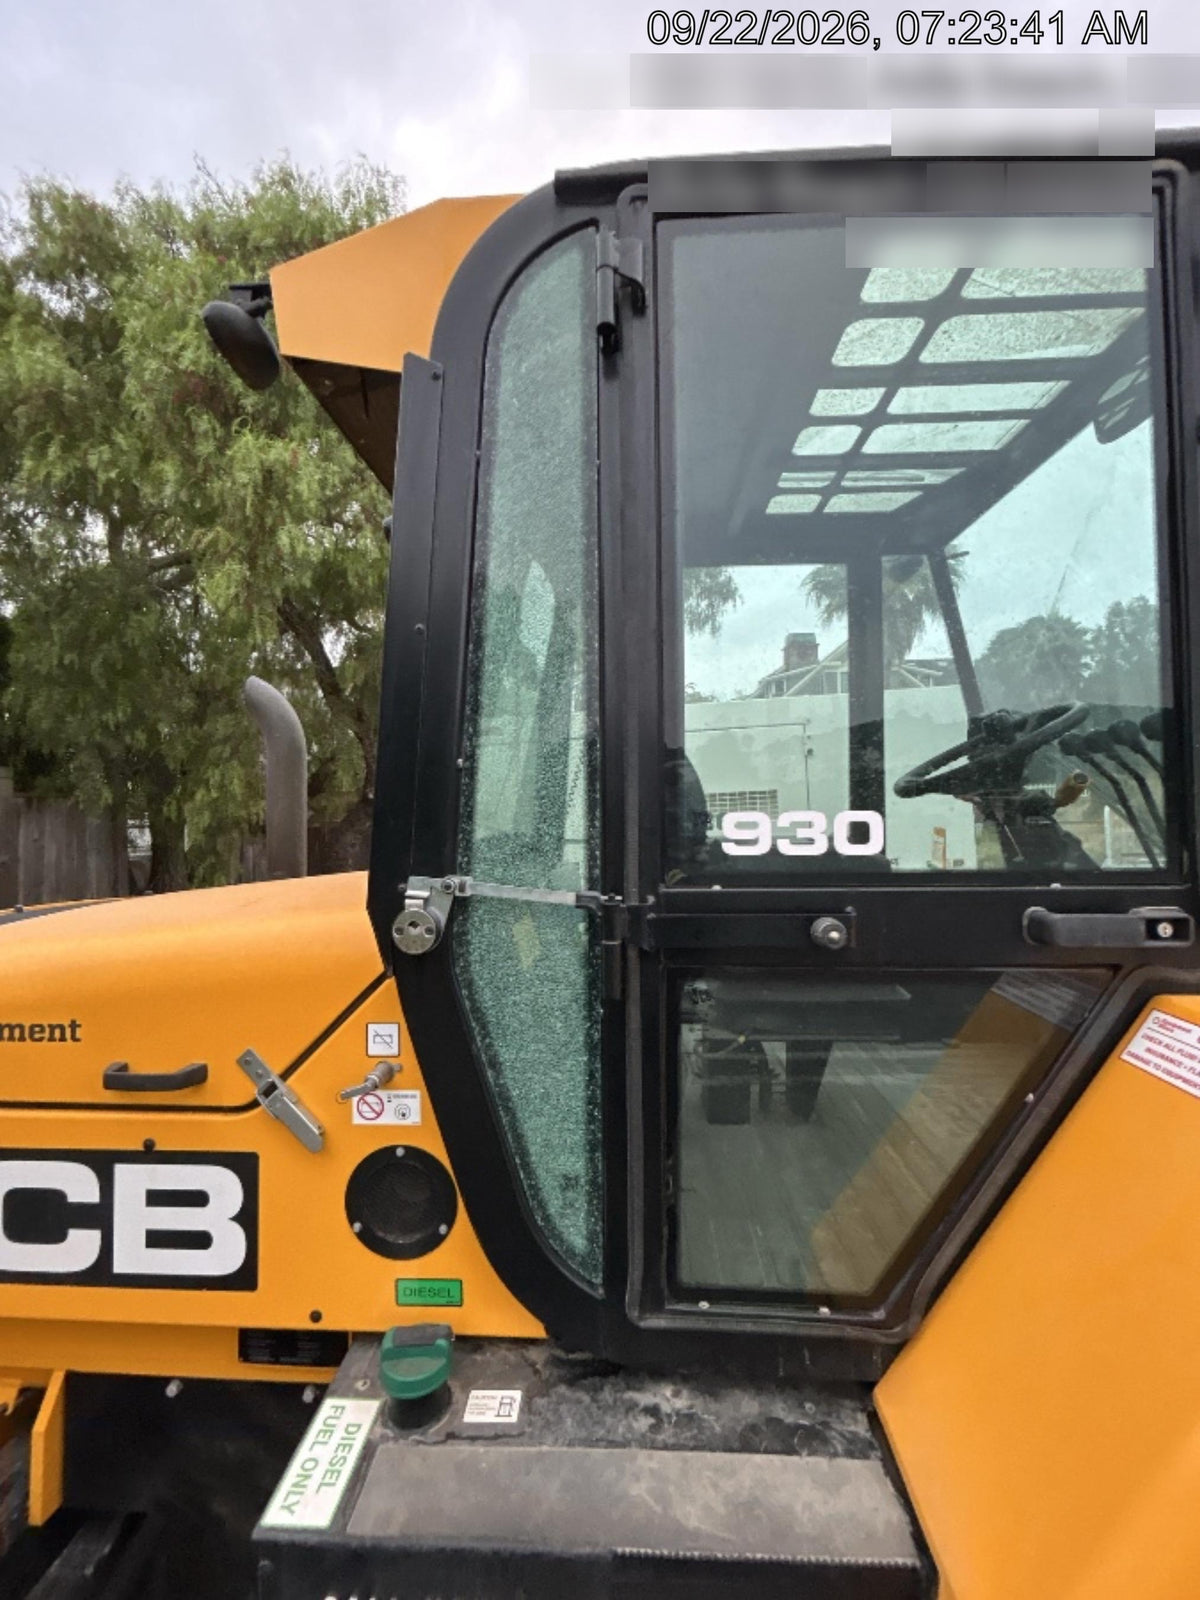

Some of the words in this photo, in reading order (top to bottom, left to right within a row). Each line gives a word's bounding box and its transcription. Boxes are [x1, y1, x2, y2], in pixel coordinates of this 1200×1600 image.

[721, 810, 884, 856] 930
[403, 1286, 455, 1299] DIESEL
[308, 1404, 346, 1452] FUEL
[315, 1423, 363, 1494] DIESEL
[280, 1457, 319, 1516] ONLY
